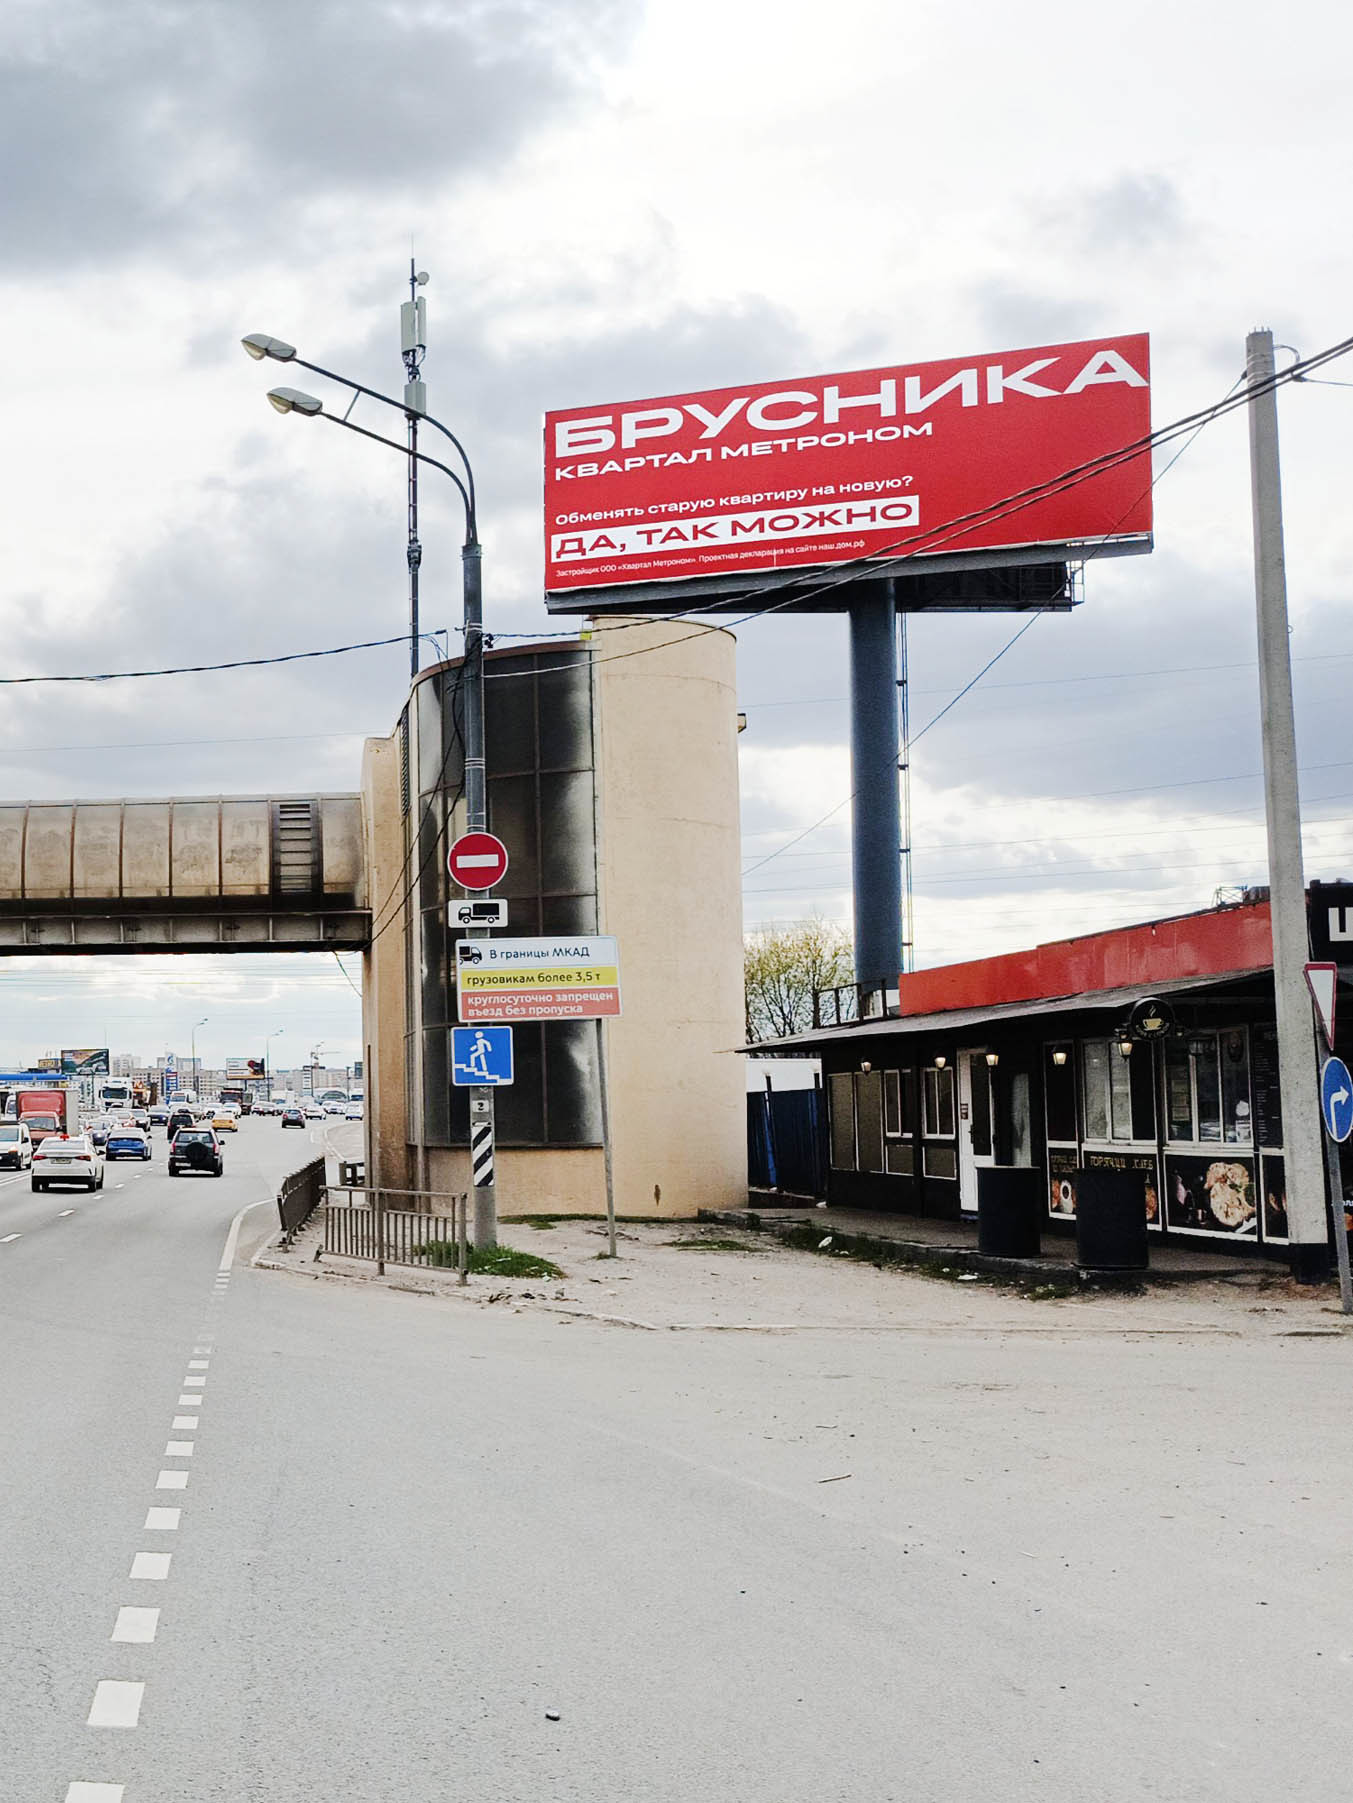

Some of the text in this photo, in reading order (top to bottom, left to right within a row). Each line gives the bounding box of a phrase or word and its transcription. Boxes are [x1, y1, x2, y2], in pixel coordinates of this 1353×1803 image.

[555, 350, 1149, 458] БРУСНИКА
[555, 422, 933, 481] КВАРТАЛ МЕТРОНОМ
[555, 475, 913, 525] Обменять старую квартиру на новую?
[556, 503, 913, 559] ДА, ТАК МОЖНО
[556, 567, 599, 577] Застройщик
[600, 565, 616, 573] ООО
[699, 551, 738, 563] Проектная
[795, 544, 817, 553] сайте
[490, 946, 591, 960] В границы МКАД
[467, 975, 535, 986] грузовикам
[538, 972, 573, 983] более
[576, 971, 593, 983] 3,5
[468, 991, 614, 1005] круглосуточно запрещен
[468, 1003, 583, 1017] въезд без пропуска
